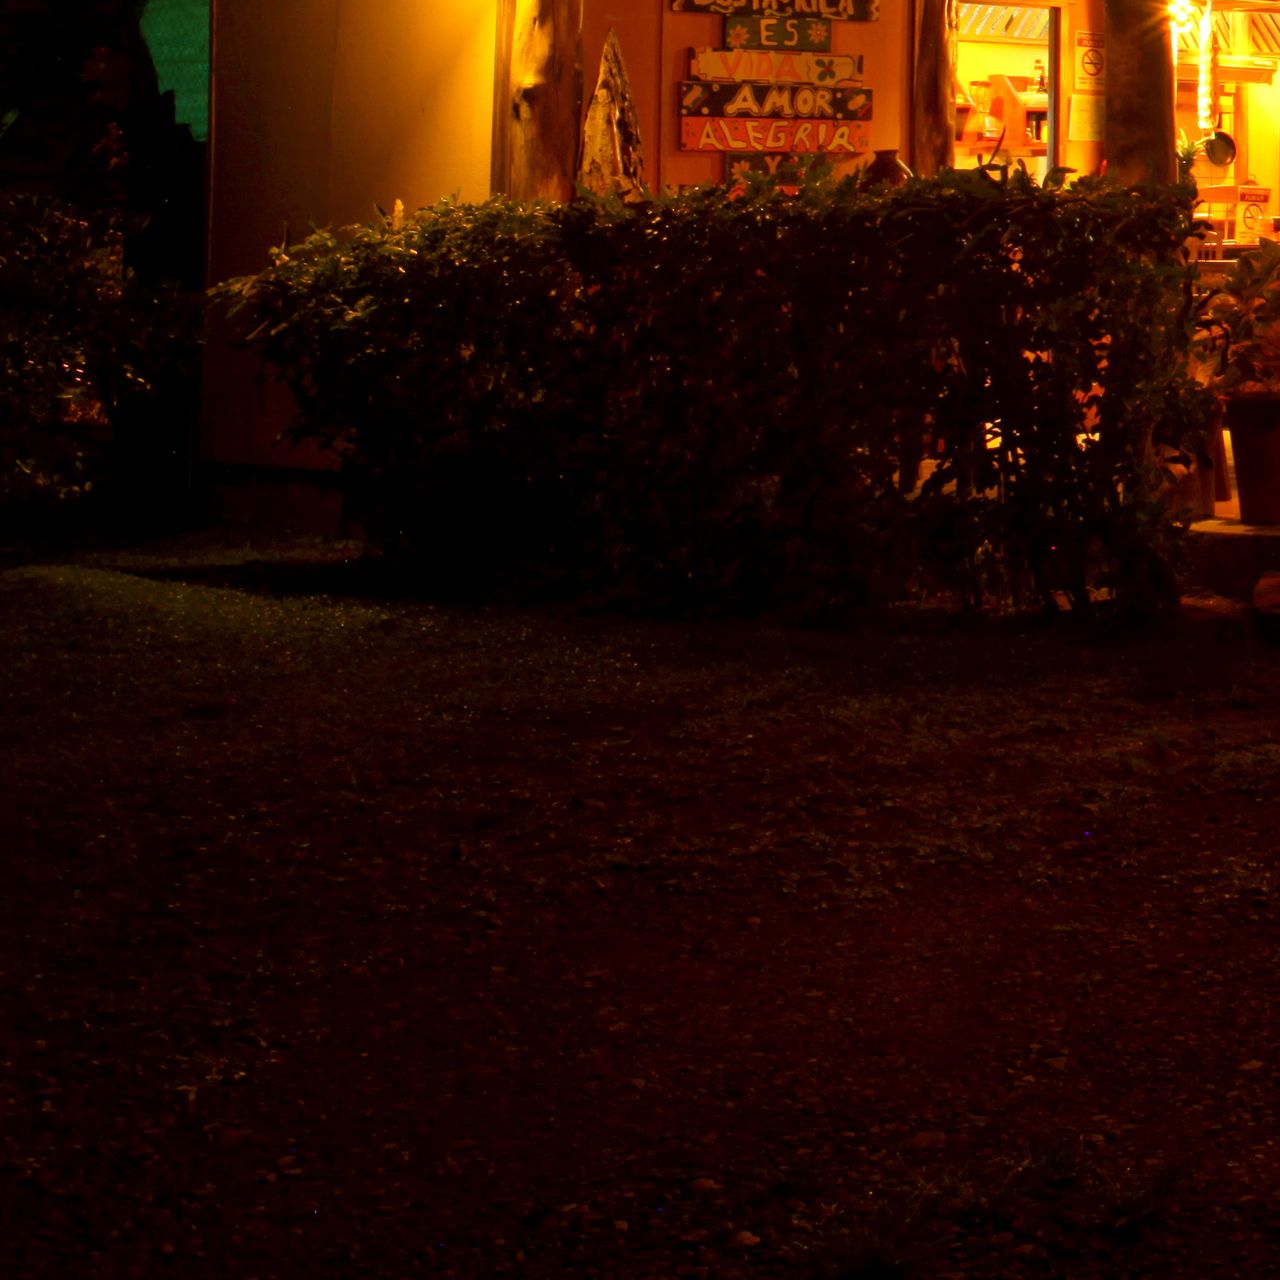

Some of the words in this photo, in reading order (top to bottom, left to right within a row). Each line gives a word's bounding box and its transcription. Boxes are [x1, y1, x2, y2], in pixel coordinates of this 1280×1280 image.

[759, 19, 799, 46] ES
[719, 53, 801, 81] VIDA
[724, 84, 835, 117] AMOR
[698, 120, 856, 151] ALEGRIA
